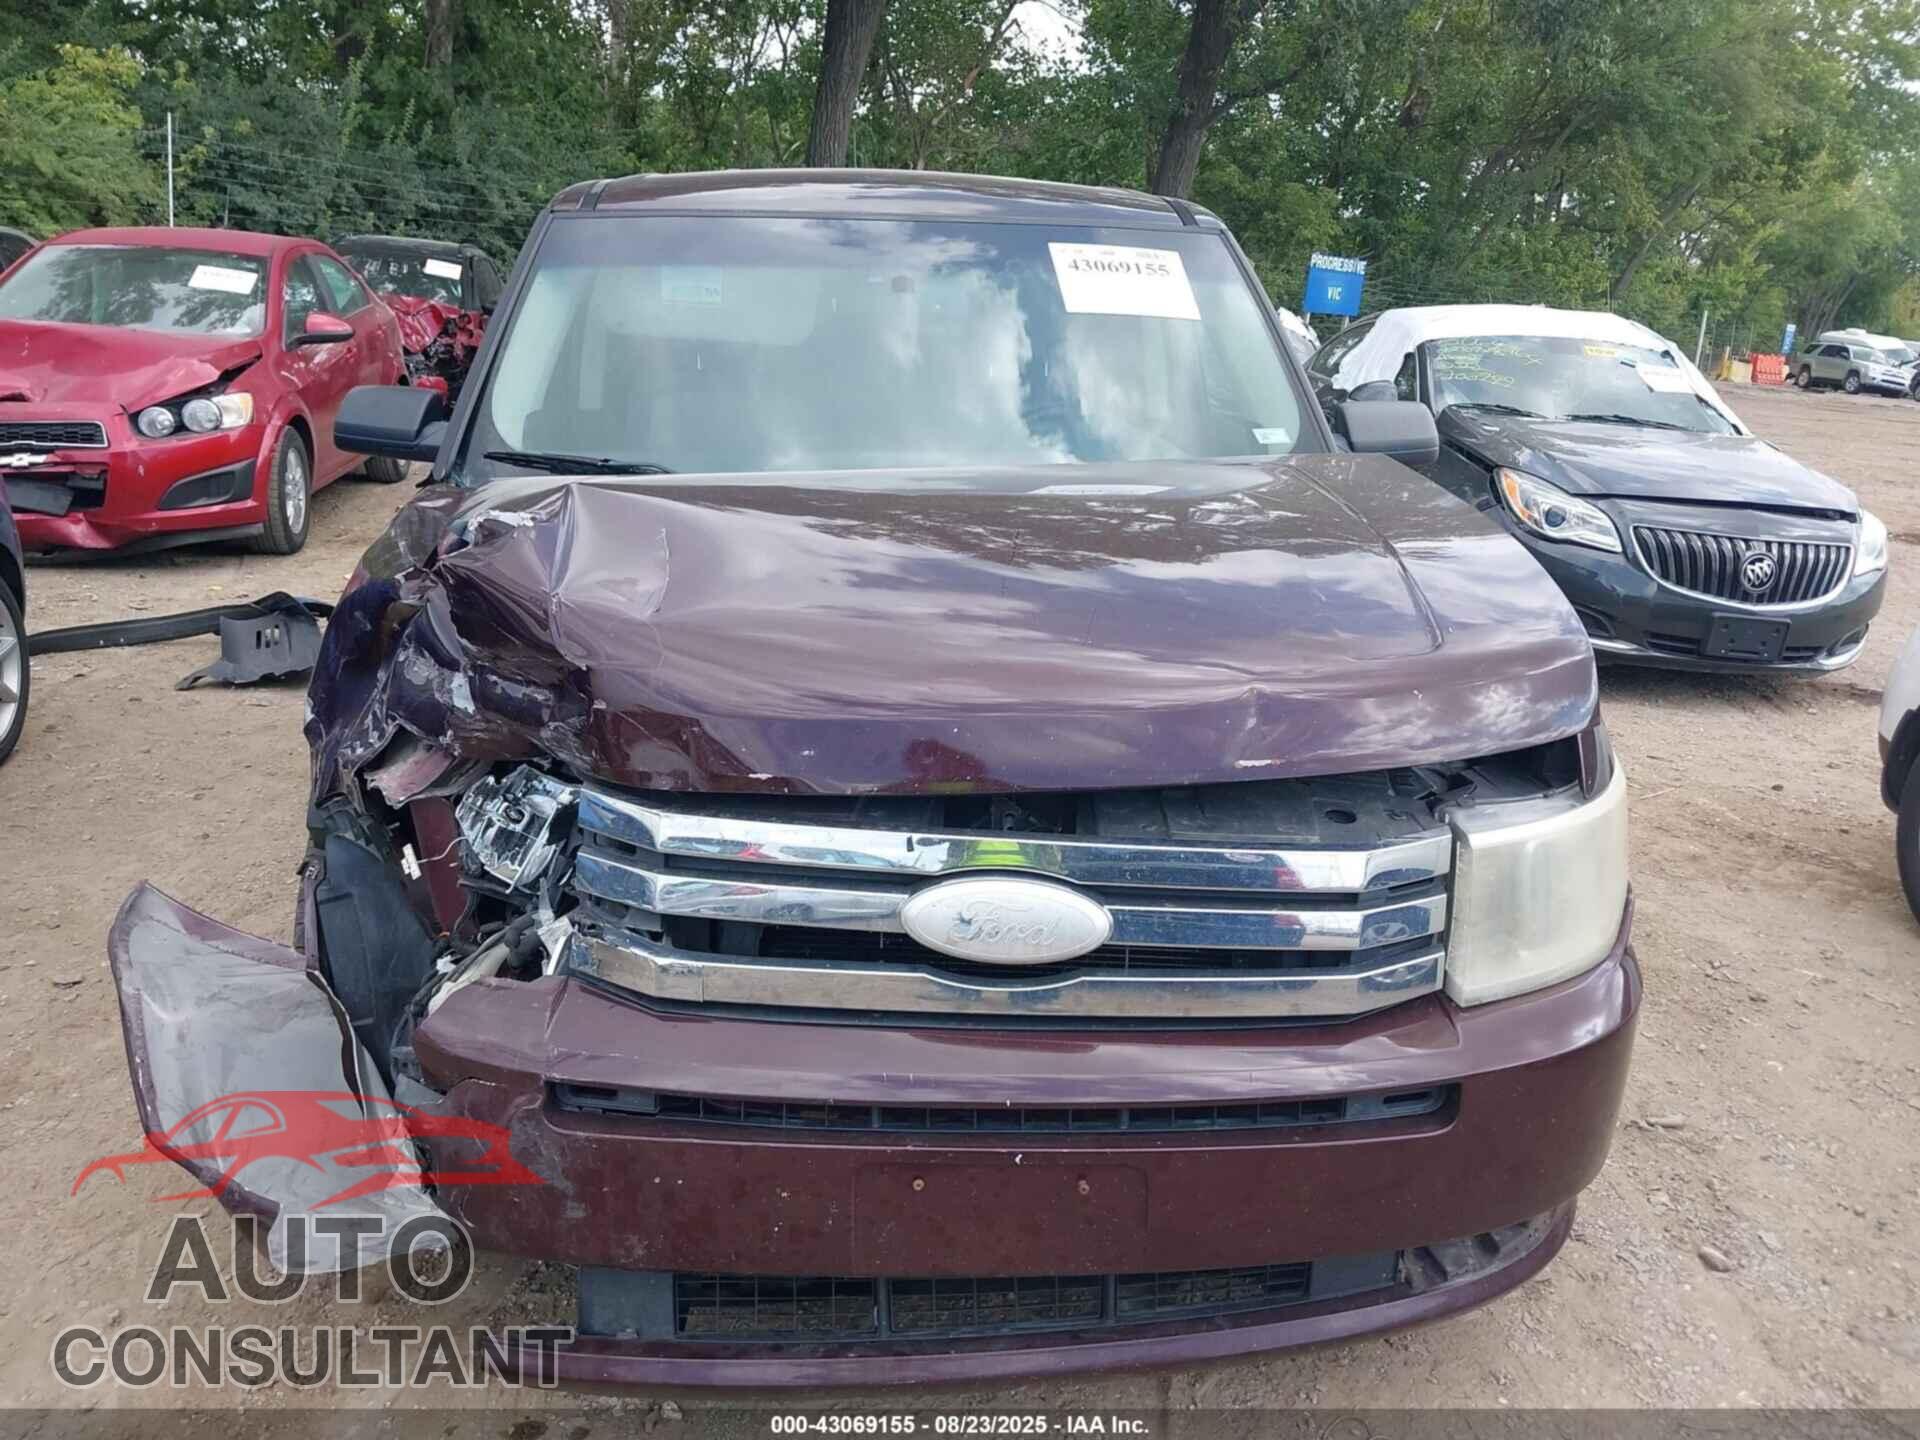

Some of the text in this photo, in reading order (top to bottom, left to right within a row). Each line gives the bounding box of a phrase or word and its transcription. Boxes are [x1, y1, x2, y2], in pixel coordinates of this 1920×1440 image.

[1067, 257, 1171, 278] 43069155
[1311, 253, 1367, 275] PROGRESSIVE
[1328, 286, 1342, 301] VIC
[950, 900, 1063, 945] Ford
